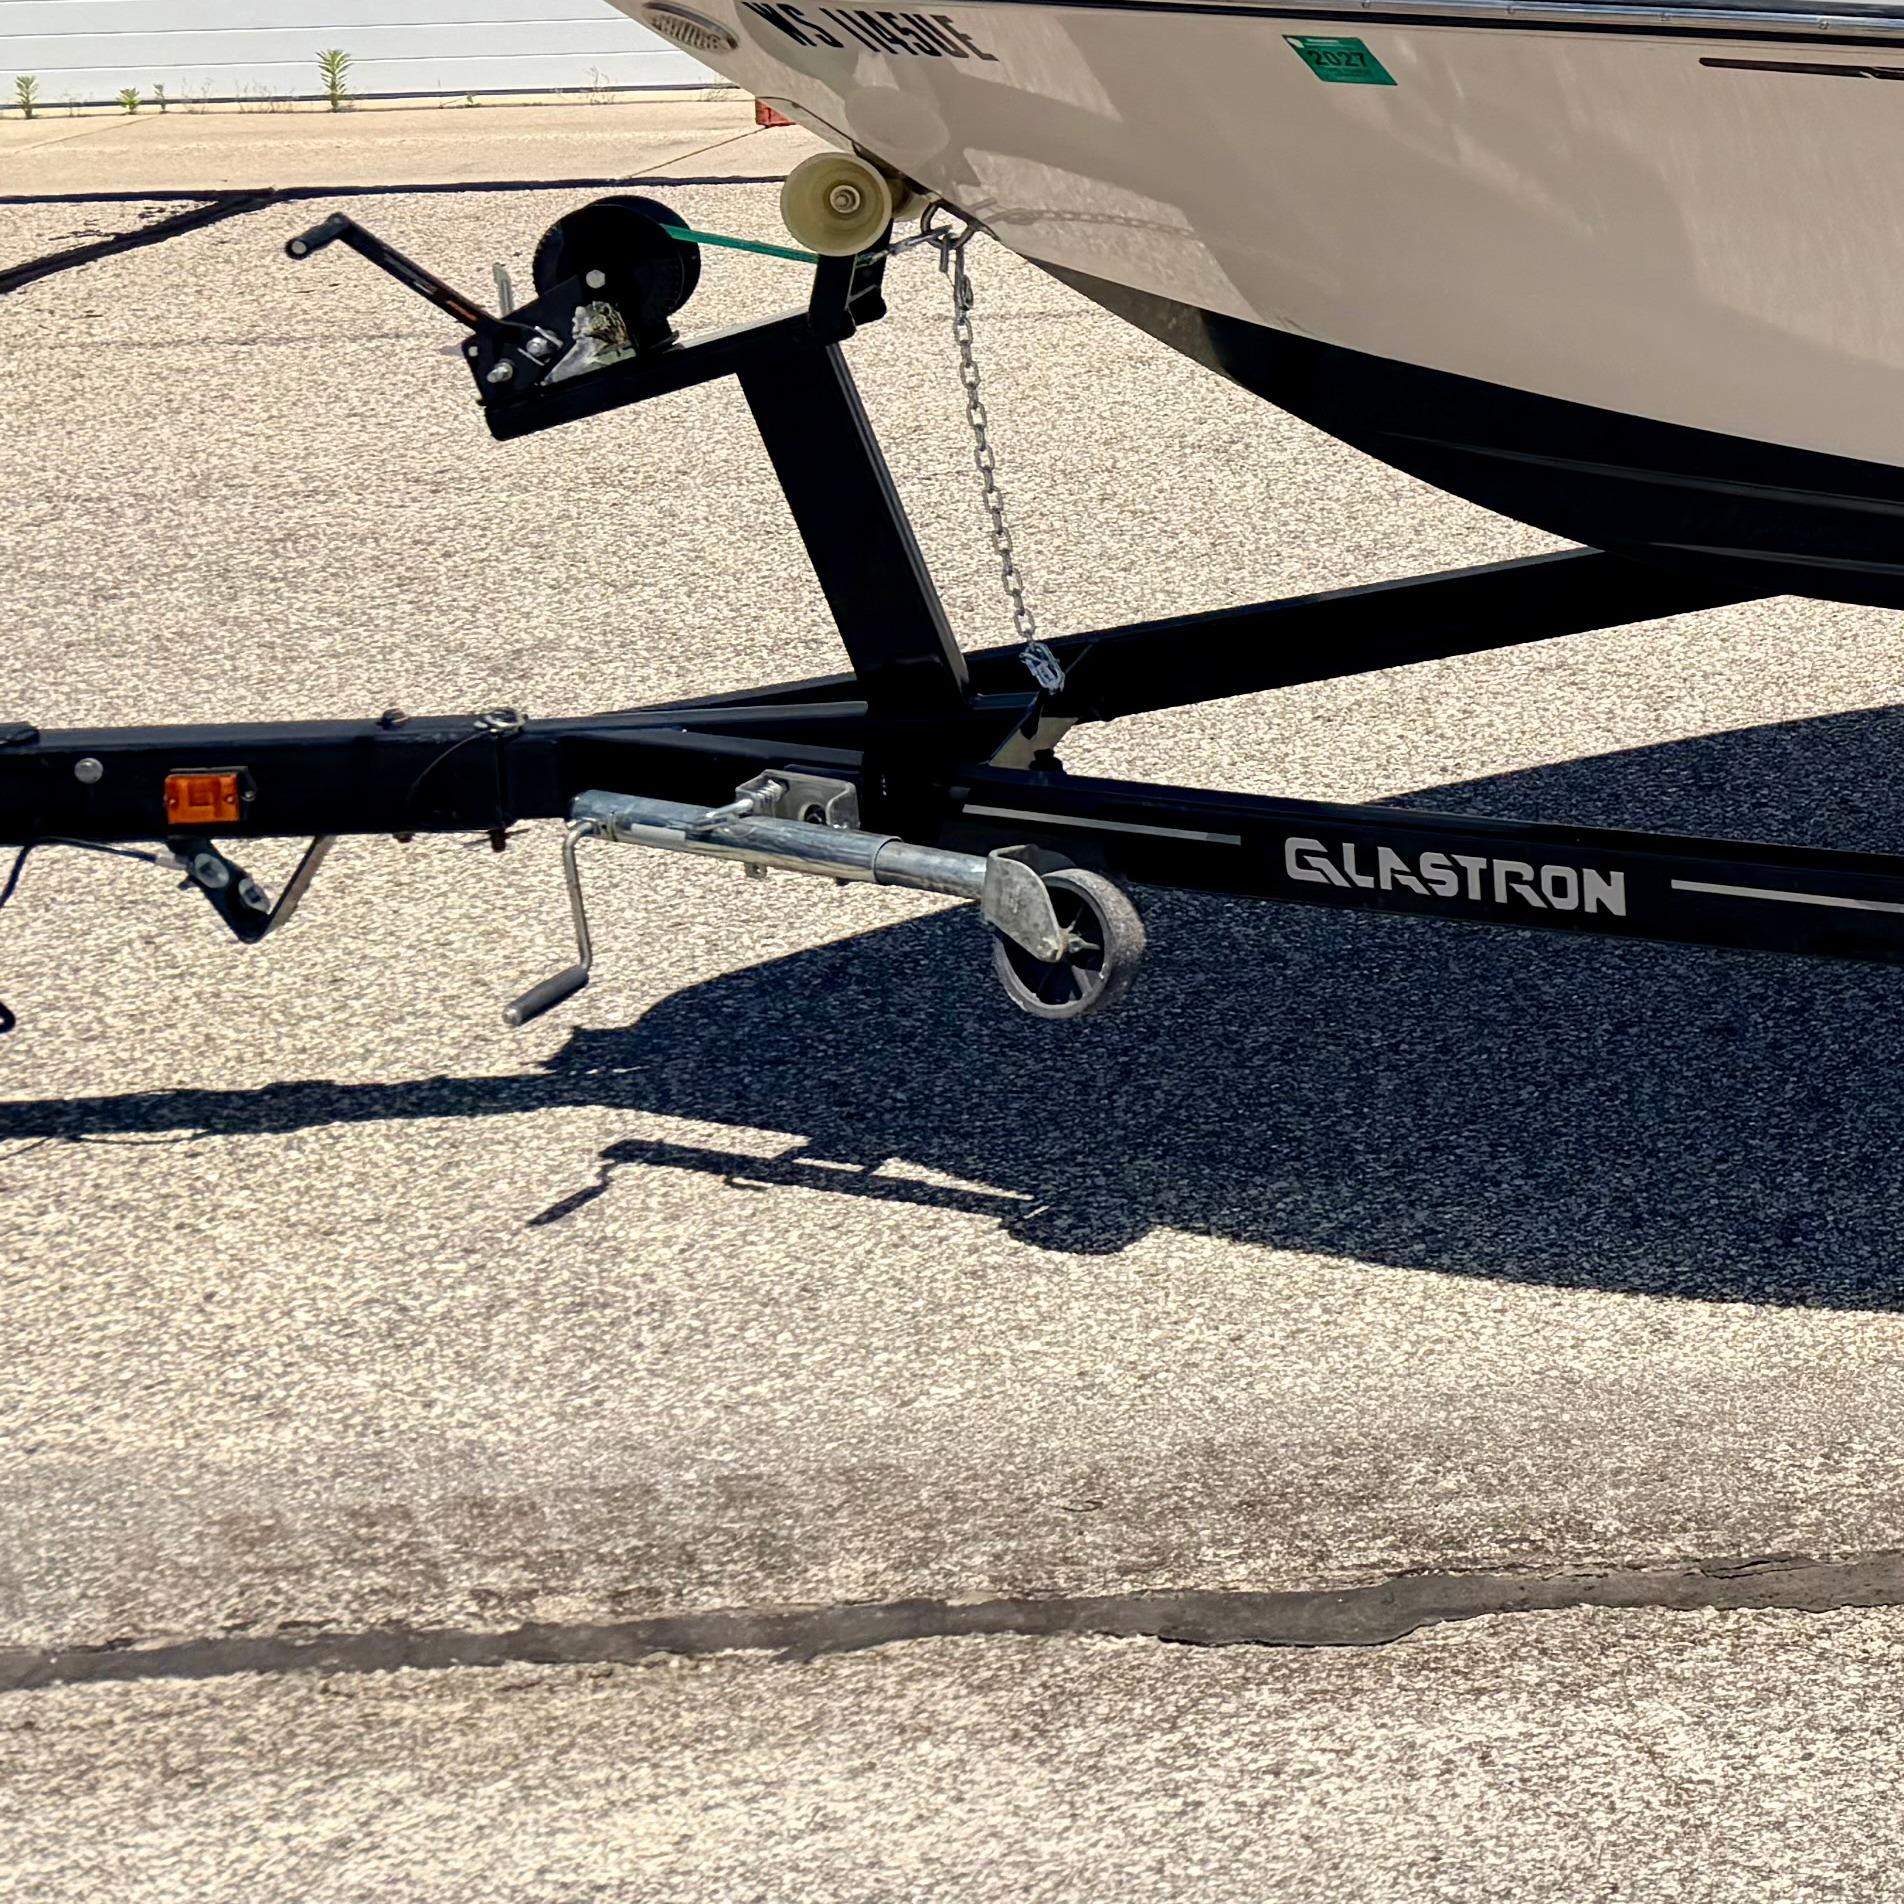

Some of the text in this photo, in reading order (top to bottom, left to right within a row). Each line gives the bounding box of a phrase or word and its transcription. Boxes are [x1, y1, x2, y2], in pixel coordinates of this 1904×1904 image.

[741, 1, 844, 48] WS
[819, 7, 1000, 62] 1145UE
[1307, 50, 1367, 67] 2027
[1284, 837, 1627, 917] GLASTRON
